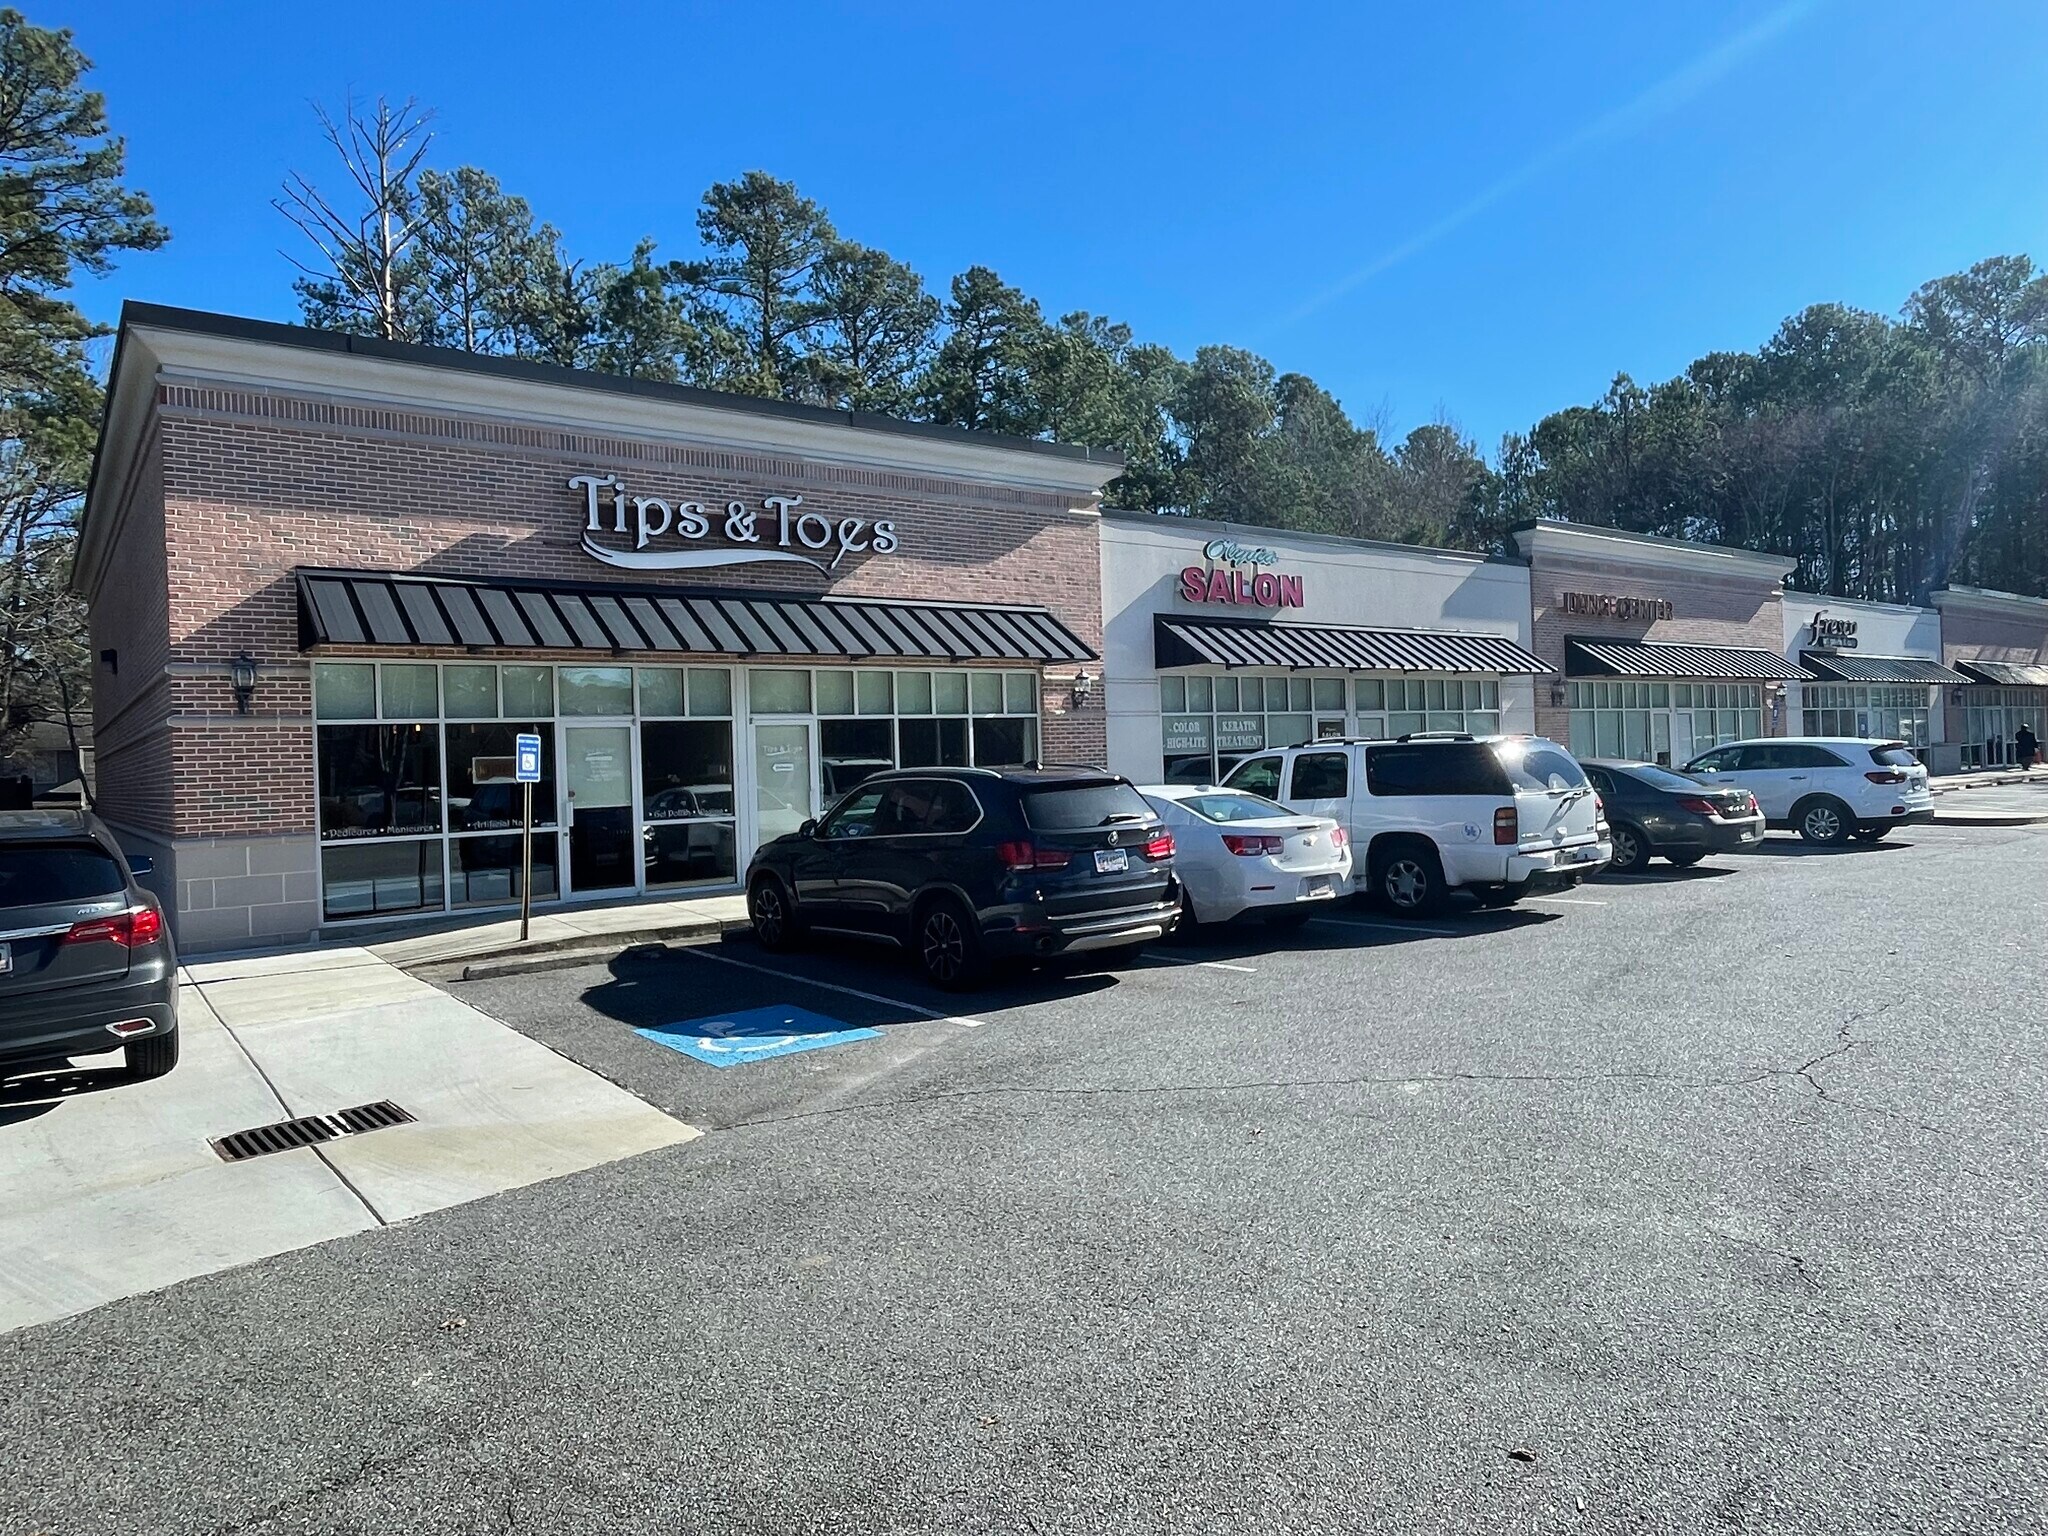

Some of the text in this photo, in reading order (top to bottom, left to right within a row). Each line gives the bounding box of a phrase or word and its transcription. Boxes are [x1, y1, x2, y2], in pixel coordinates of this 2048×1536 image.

[568, 474, 899, 570] Tips & Toes
[1180, 566, 1305, 608] SALON
[1617, 596, 1674, 621] CENTER
[1172, 721, 1201, 733] COLOR
[1222, 720, 1257, 732] KERATIN
[1166, 736, 1208, 749] HIGH-LITE
[1216, 735, 1263, 748] TREATMENT
[328, 824, 434, 838] Pedicures Manicures
